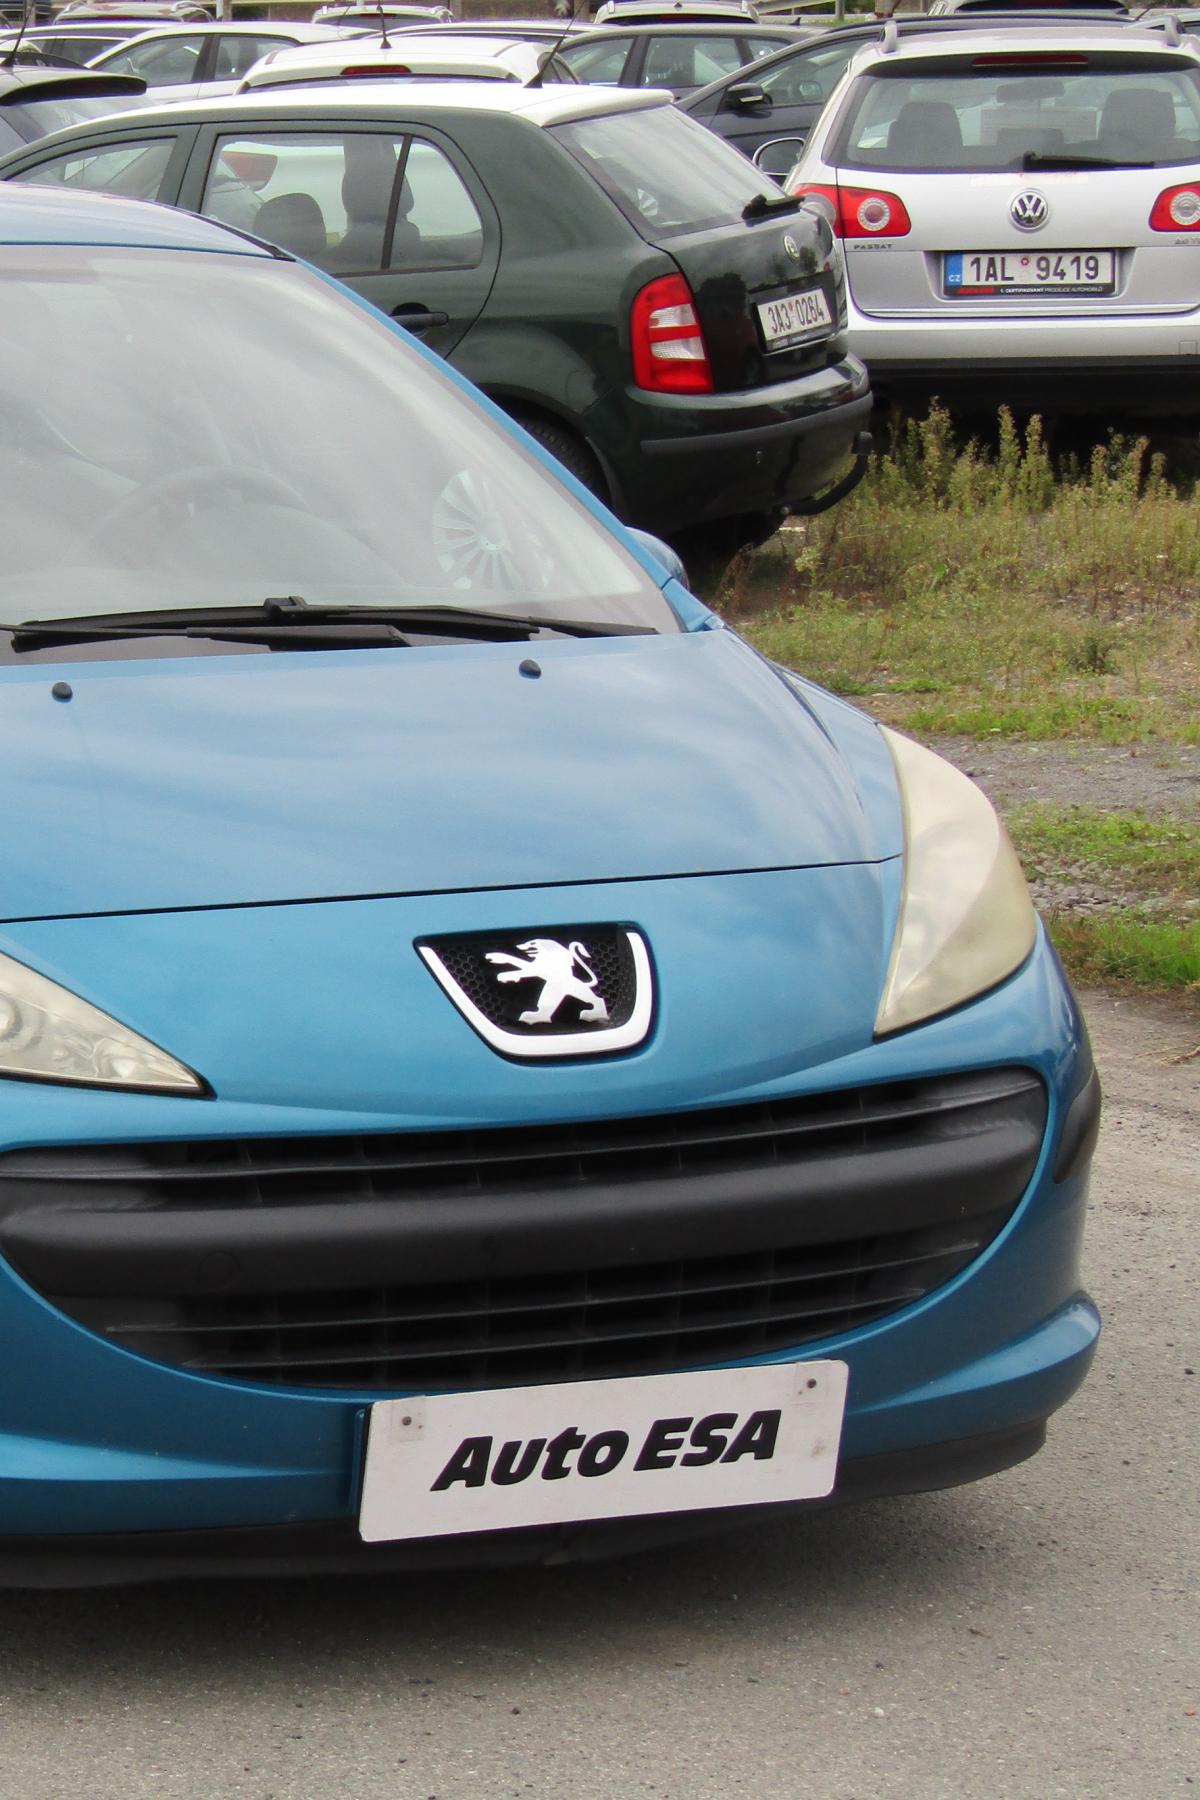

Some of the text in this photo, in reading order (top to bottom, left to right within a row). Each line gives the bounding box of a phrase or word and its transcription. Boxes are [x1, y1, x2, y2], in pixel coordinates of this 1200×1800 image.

[948, 274, 961, 282] CZ
[970, 255, 1100, 282] 1AL 9419
[795, 294, 825, 327] 0264
[430, 1409, 781, 1491] Auto ESA
